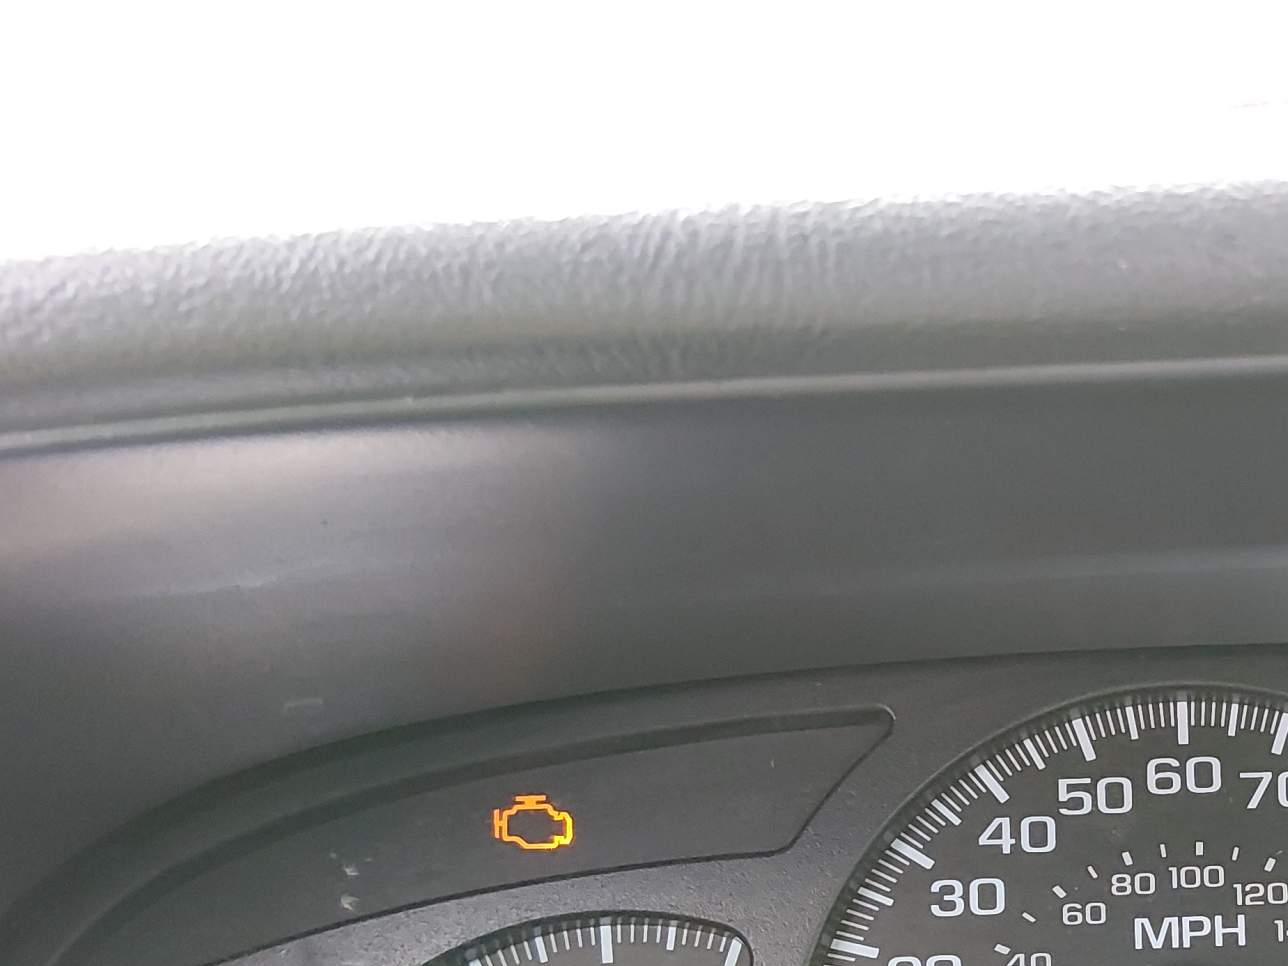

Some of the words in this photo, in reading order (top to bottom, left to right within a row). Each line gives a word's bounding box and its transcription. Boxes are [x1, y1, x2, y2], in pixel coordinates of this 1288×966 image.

[1146, 756, 1222, 795] 60
[1058, 776, 1133, 816] 50
[978, 815, 1057, 854] 40
[1111, 872, 1156, 896] 80
[1168, 865, 1225, 889] 100
[1233, 882, 1288, 906] 120
[930, 878, 1006, 917] 30
[1062, 902, 1107, 925] 60
[1134, 914, 1246, 950] MPH
